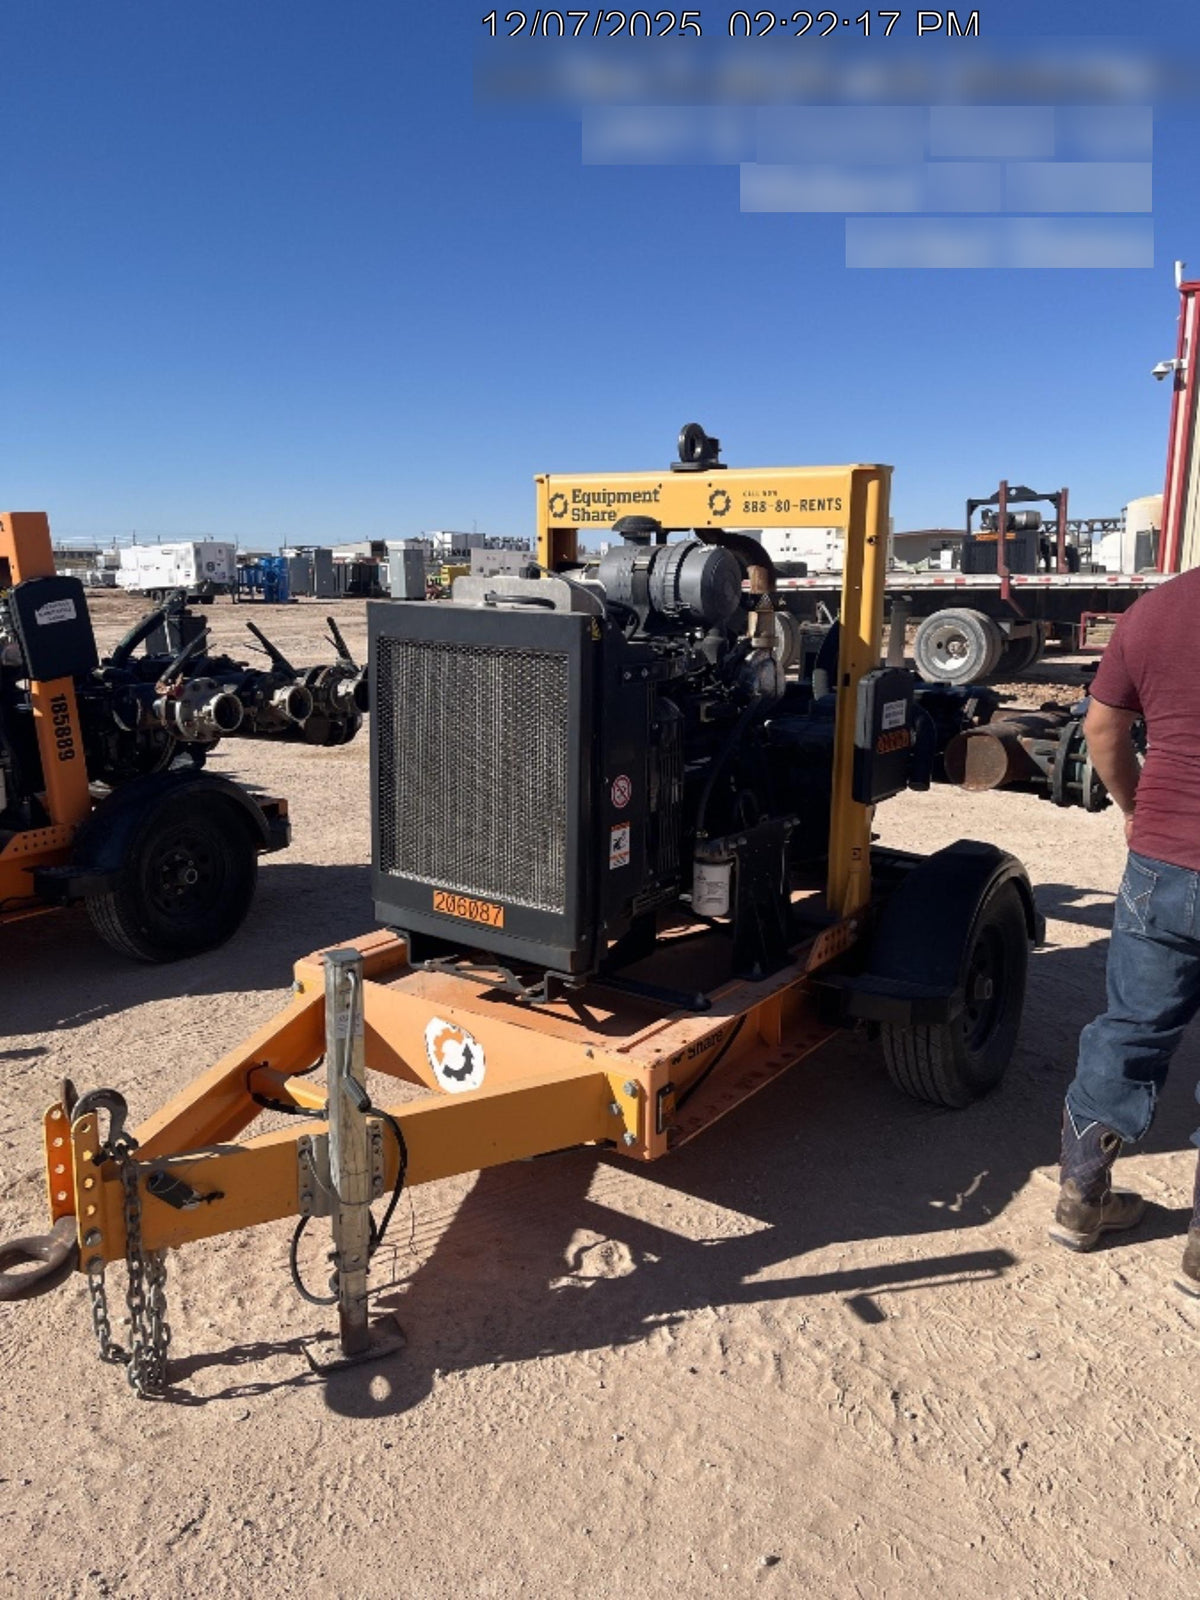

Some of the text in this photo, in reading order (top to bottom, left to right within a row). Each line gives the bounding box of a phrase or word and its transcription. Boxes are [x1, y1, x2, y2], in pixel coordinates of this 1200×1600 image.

[572, 488, 660, 507] Equipment
[742, 498, 842, 513] 888-80-RENTS
[571, 507, 617, 521] Share
[434, 891, 502, 925] 206087
